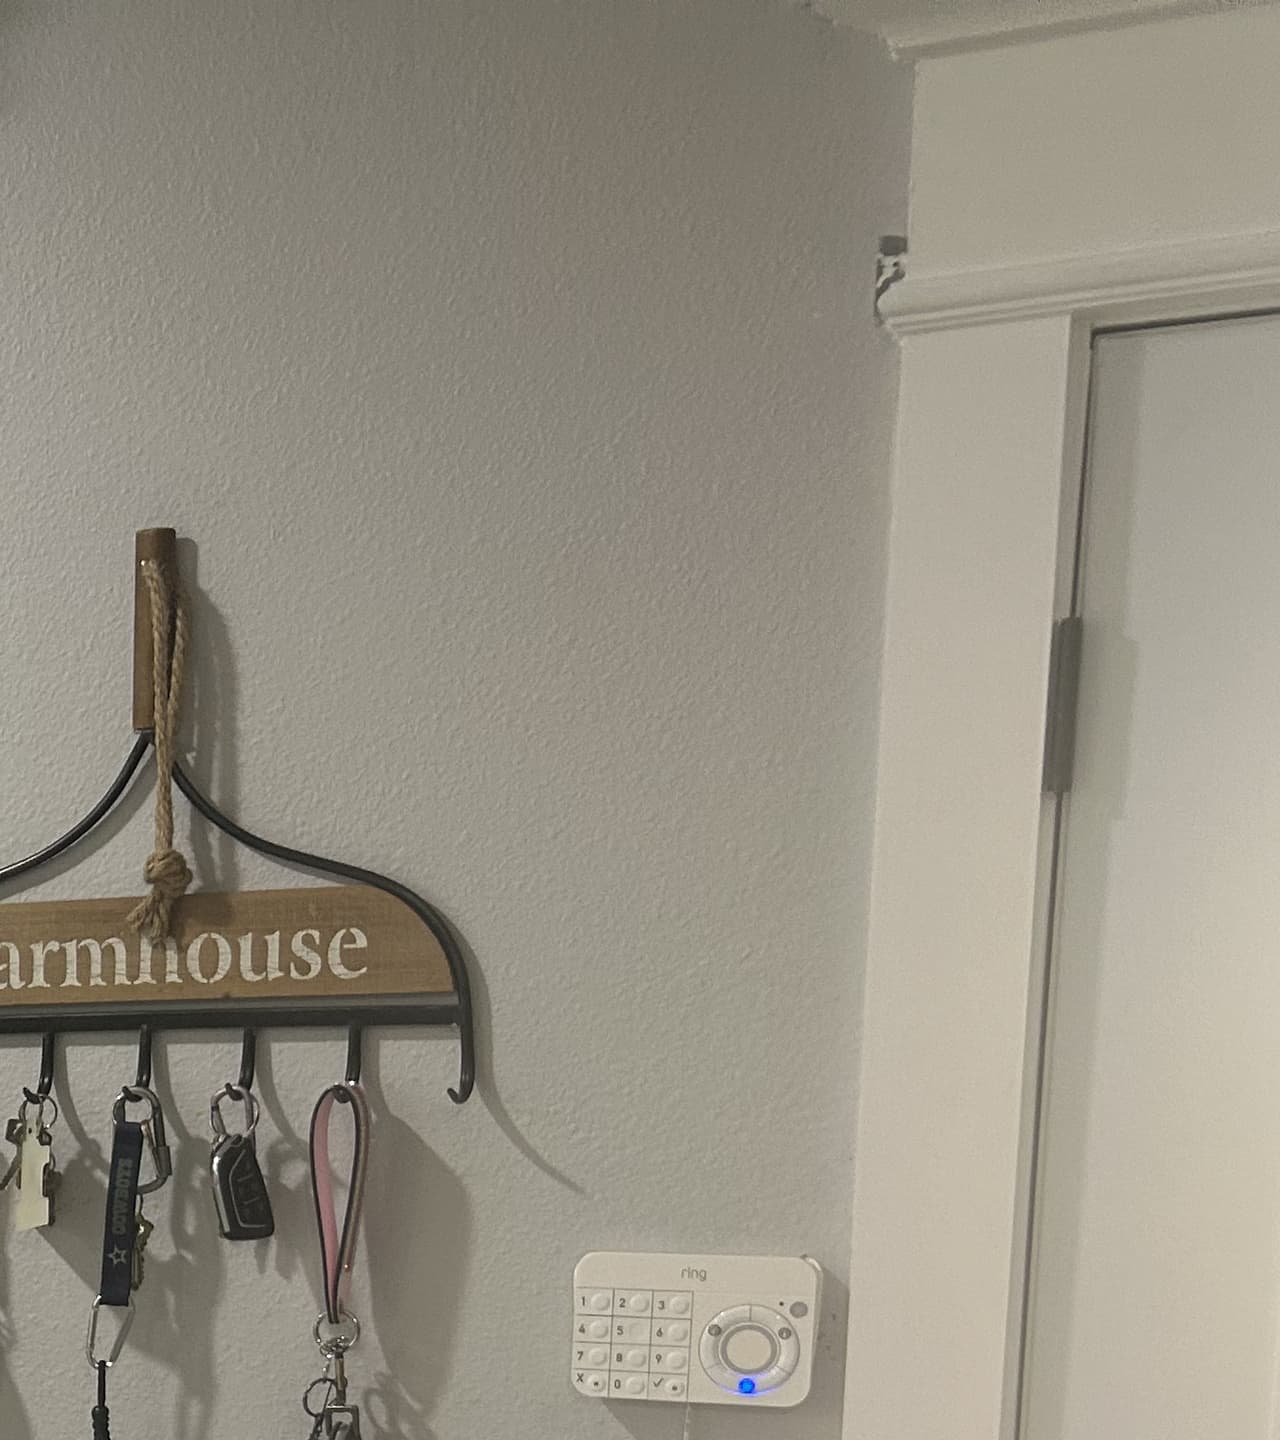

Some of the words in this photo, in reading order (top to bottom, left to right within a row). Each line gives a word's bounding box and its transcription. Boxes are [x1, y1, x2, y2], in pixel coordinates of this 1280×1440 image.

[110, 1158, 134, 1235] COWBOYS
[681, 1266, 707, 1281] ring
[619, 1298, 626, 1308] 2
[658, 1301, 665, 1310] 3
[578, 1325, 586, 1335] 4
[616, 1326, 624, 1336] 5
[656, 1327, 663, 1337] 6
[577, 1352, 584, 1361] 7
[616, 1353, 622, 1363] 8
[655, 1354, 662, 1364] 9
